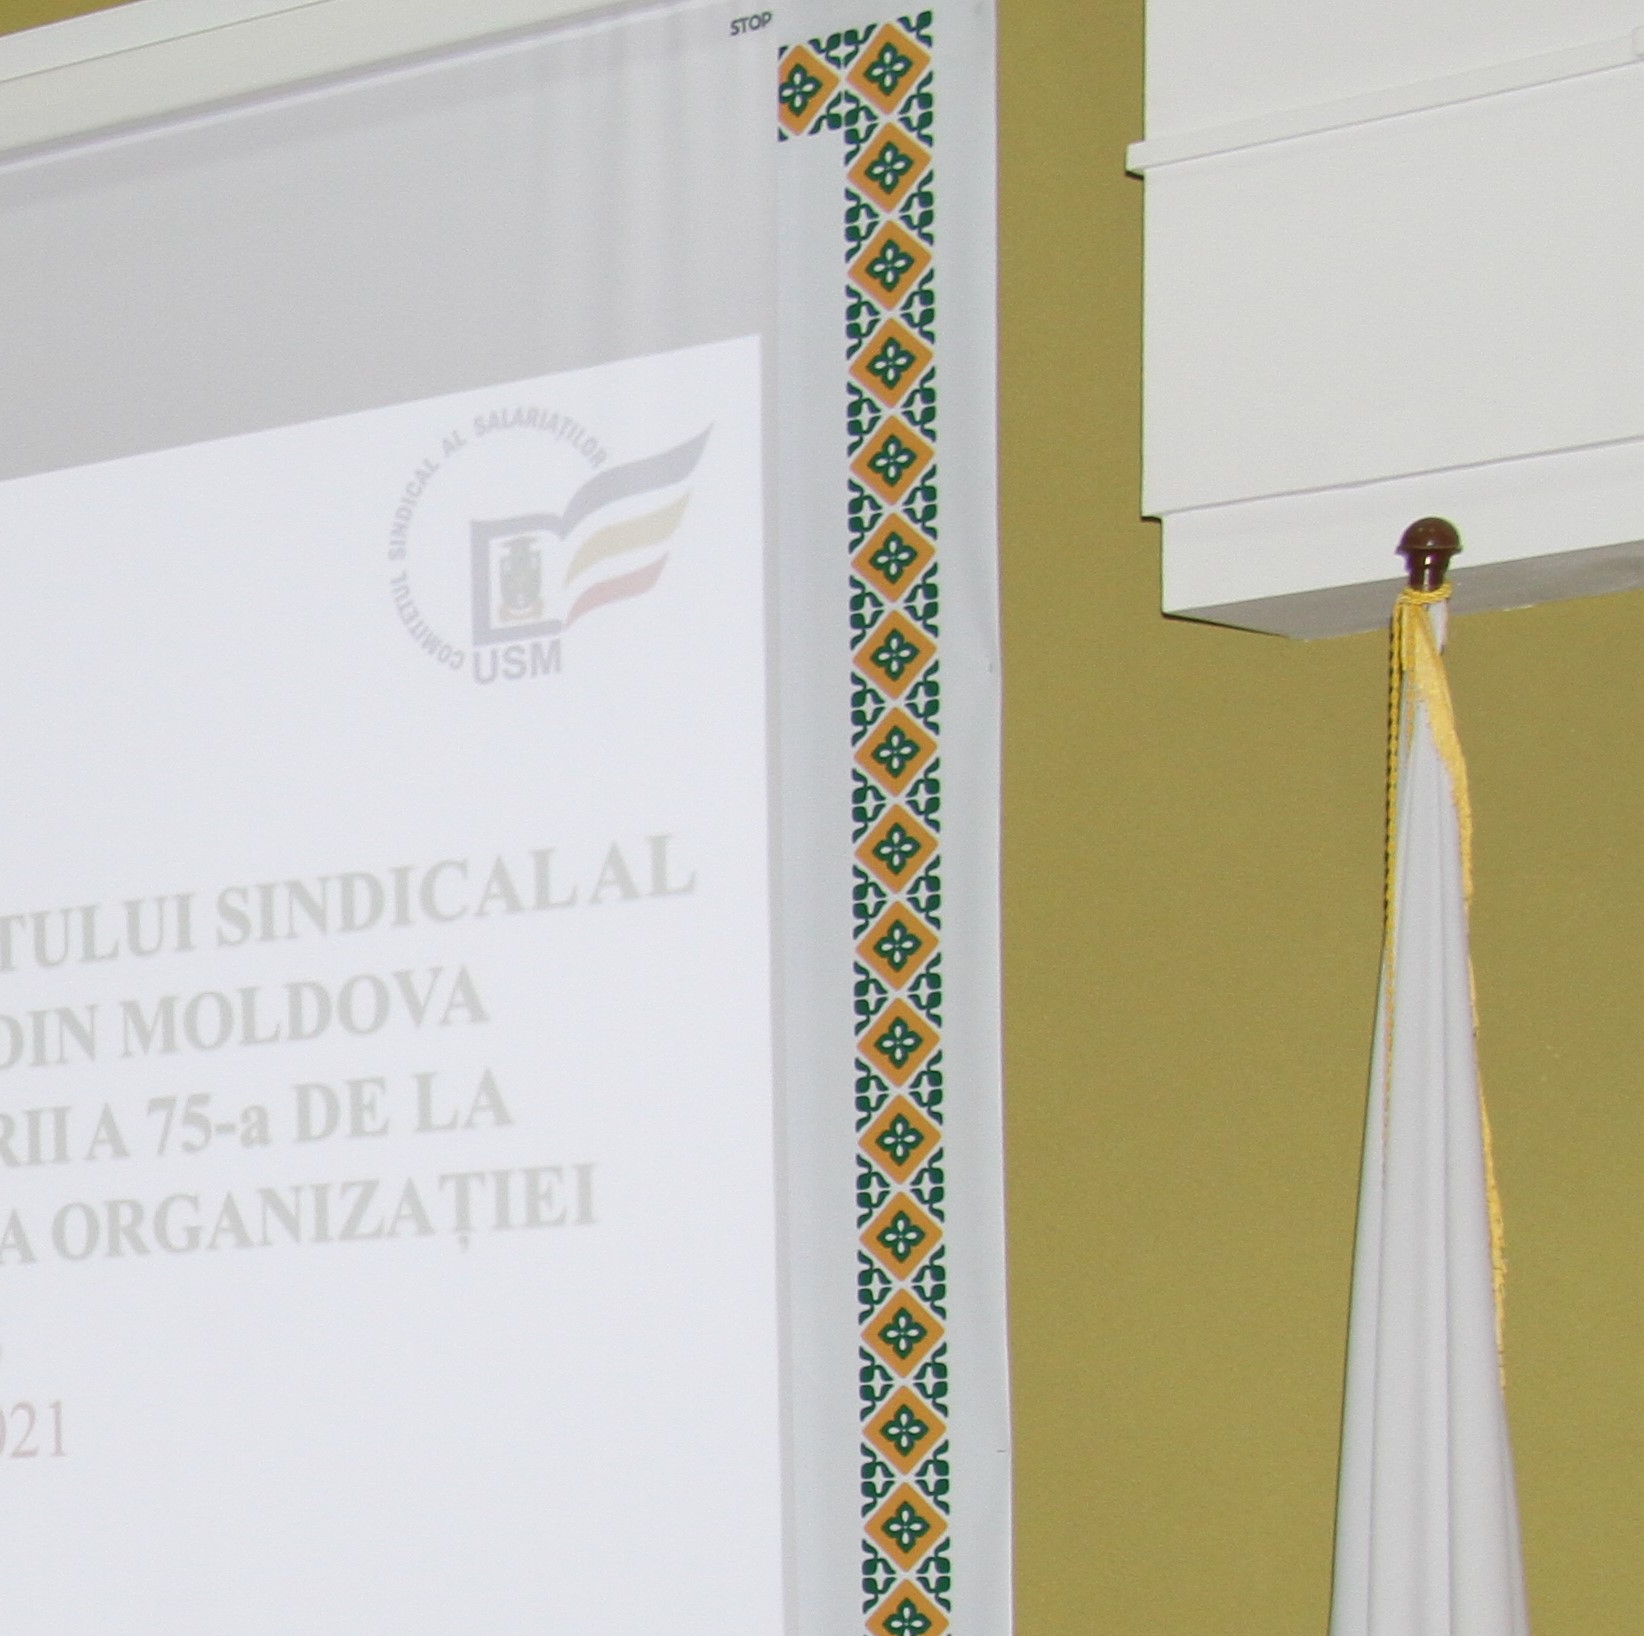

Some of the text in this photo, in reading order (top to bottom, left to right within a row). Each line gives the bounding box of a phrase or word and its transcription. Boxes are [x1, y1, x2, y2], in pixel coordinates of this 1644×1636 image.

[730, 11, 773, 36] STOP
[387, 457, 440, 562] SINDICAL
[441, 429, 469, 458] AL
[472, 637, 562, 685] USM
[215, 847, 578, 948] SINDICAL
[588, 833, 697, 906] AL
[119, 965, 490, 1059] MOLDOVA
[84, 1102, 131, 1163] A
[145, 1091, 273, 1157] 75-a
[293, 1075, 390, 1145] DE
[412, 1068, 514, 1135] LA
